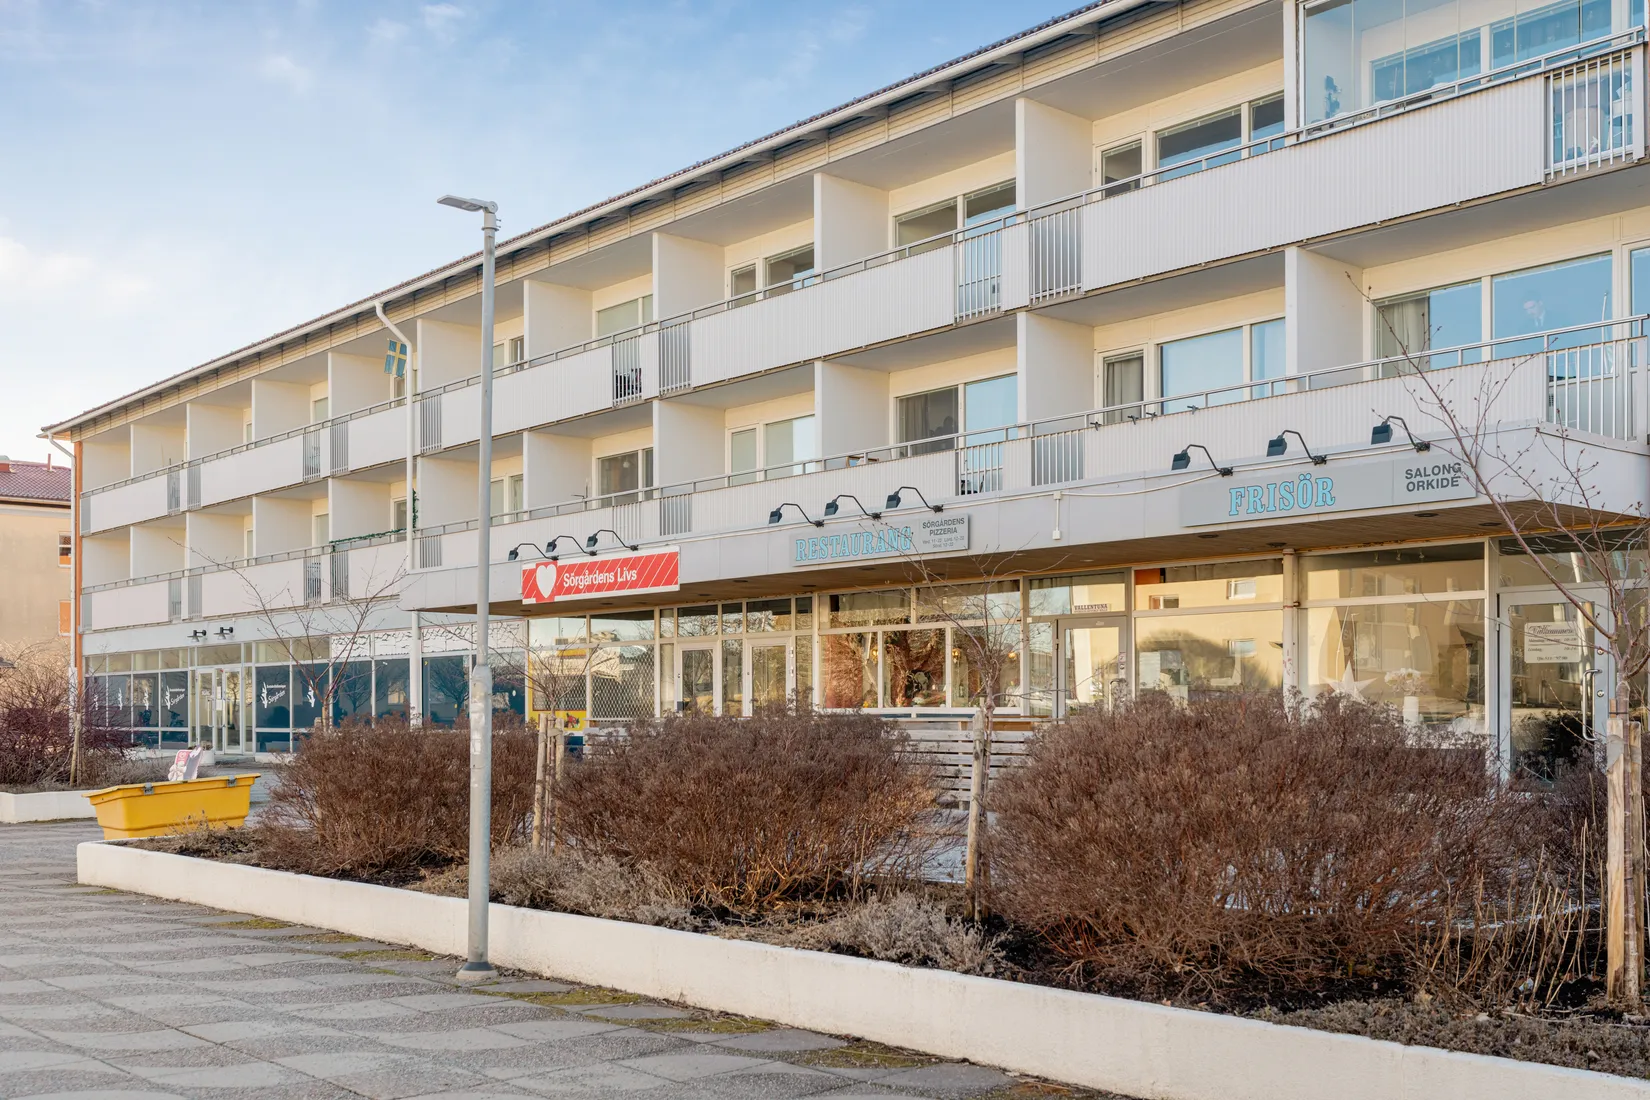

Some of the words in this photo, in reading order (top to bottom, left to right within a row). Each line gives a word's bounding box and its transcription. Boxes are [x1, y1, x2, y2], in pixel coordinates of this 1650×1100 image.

[1405, 462, 1462, 480] SALONG
[1406, 474, 1460, 492] ORKIDÉ
[1228, 473, 1336, 516] FRISÖR
[922, 517, 965, 529] SÖRGÅRDENS
[929, 527, 958, 536] PIZZERIA
[795, 526, 913, 562] RESTAURANG
[563, 570, 615, 588] Sörgårdens
[617, 567, 637, 582] Livs
